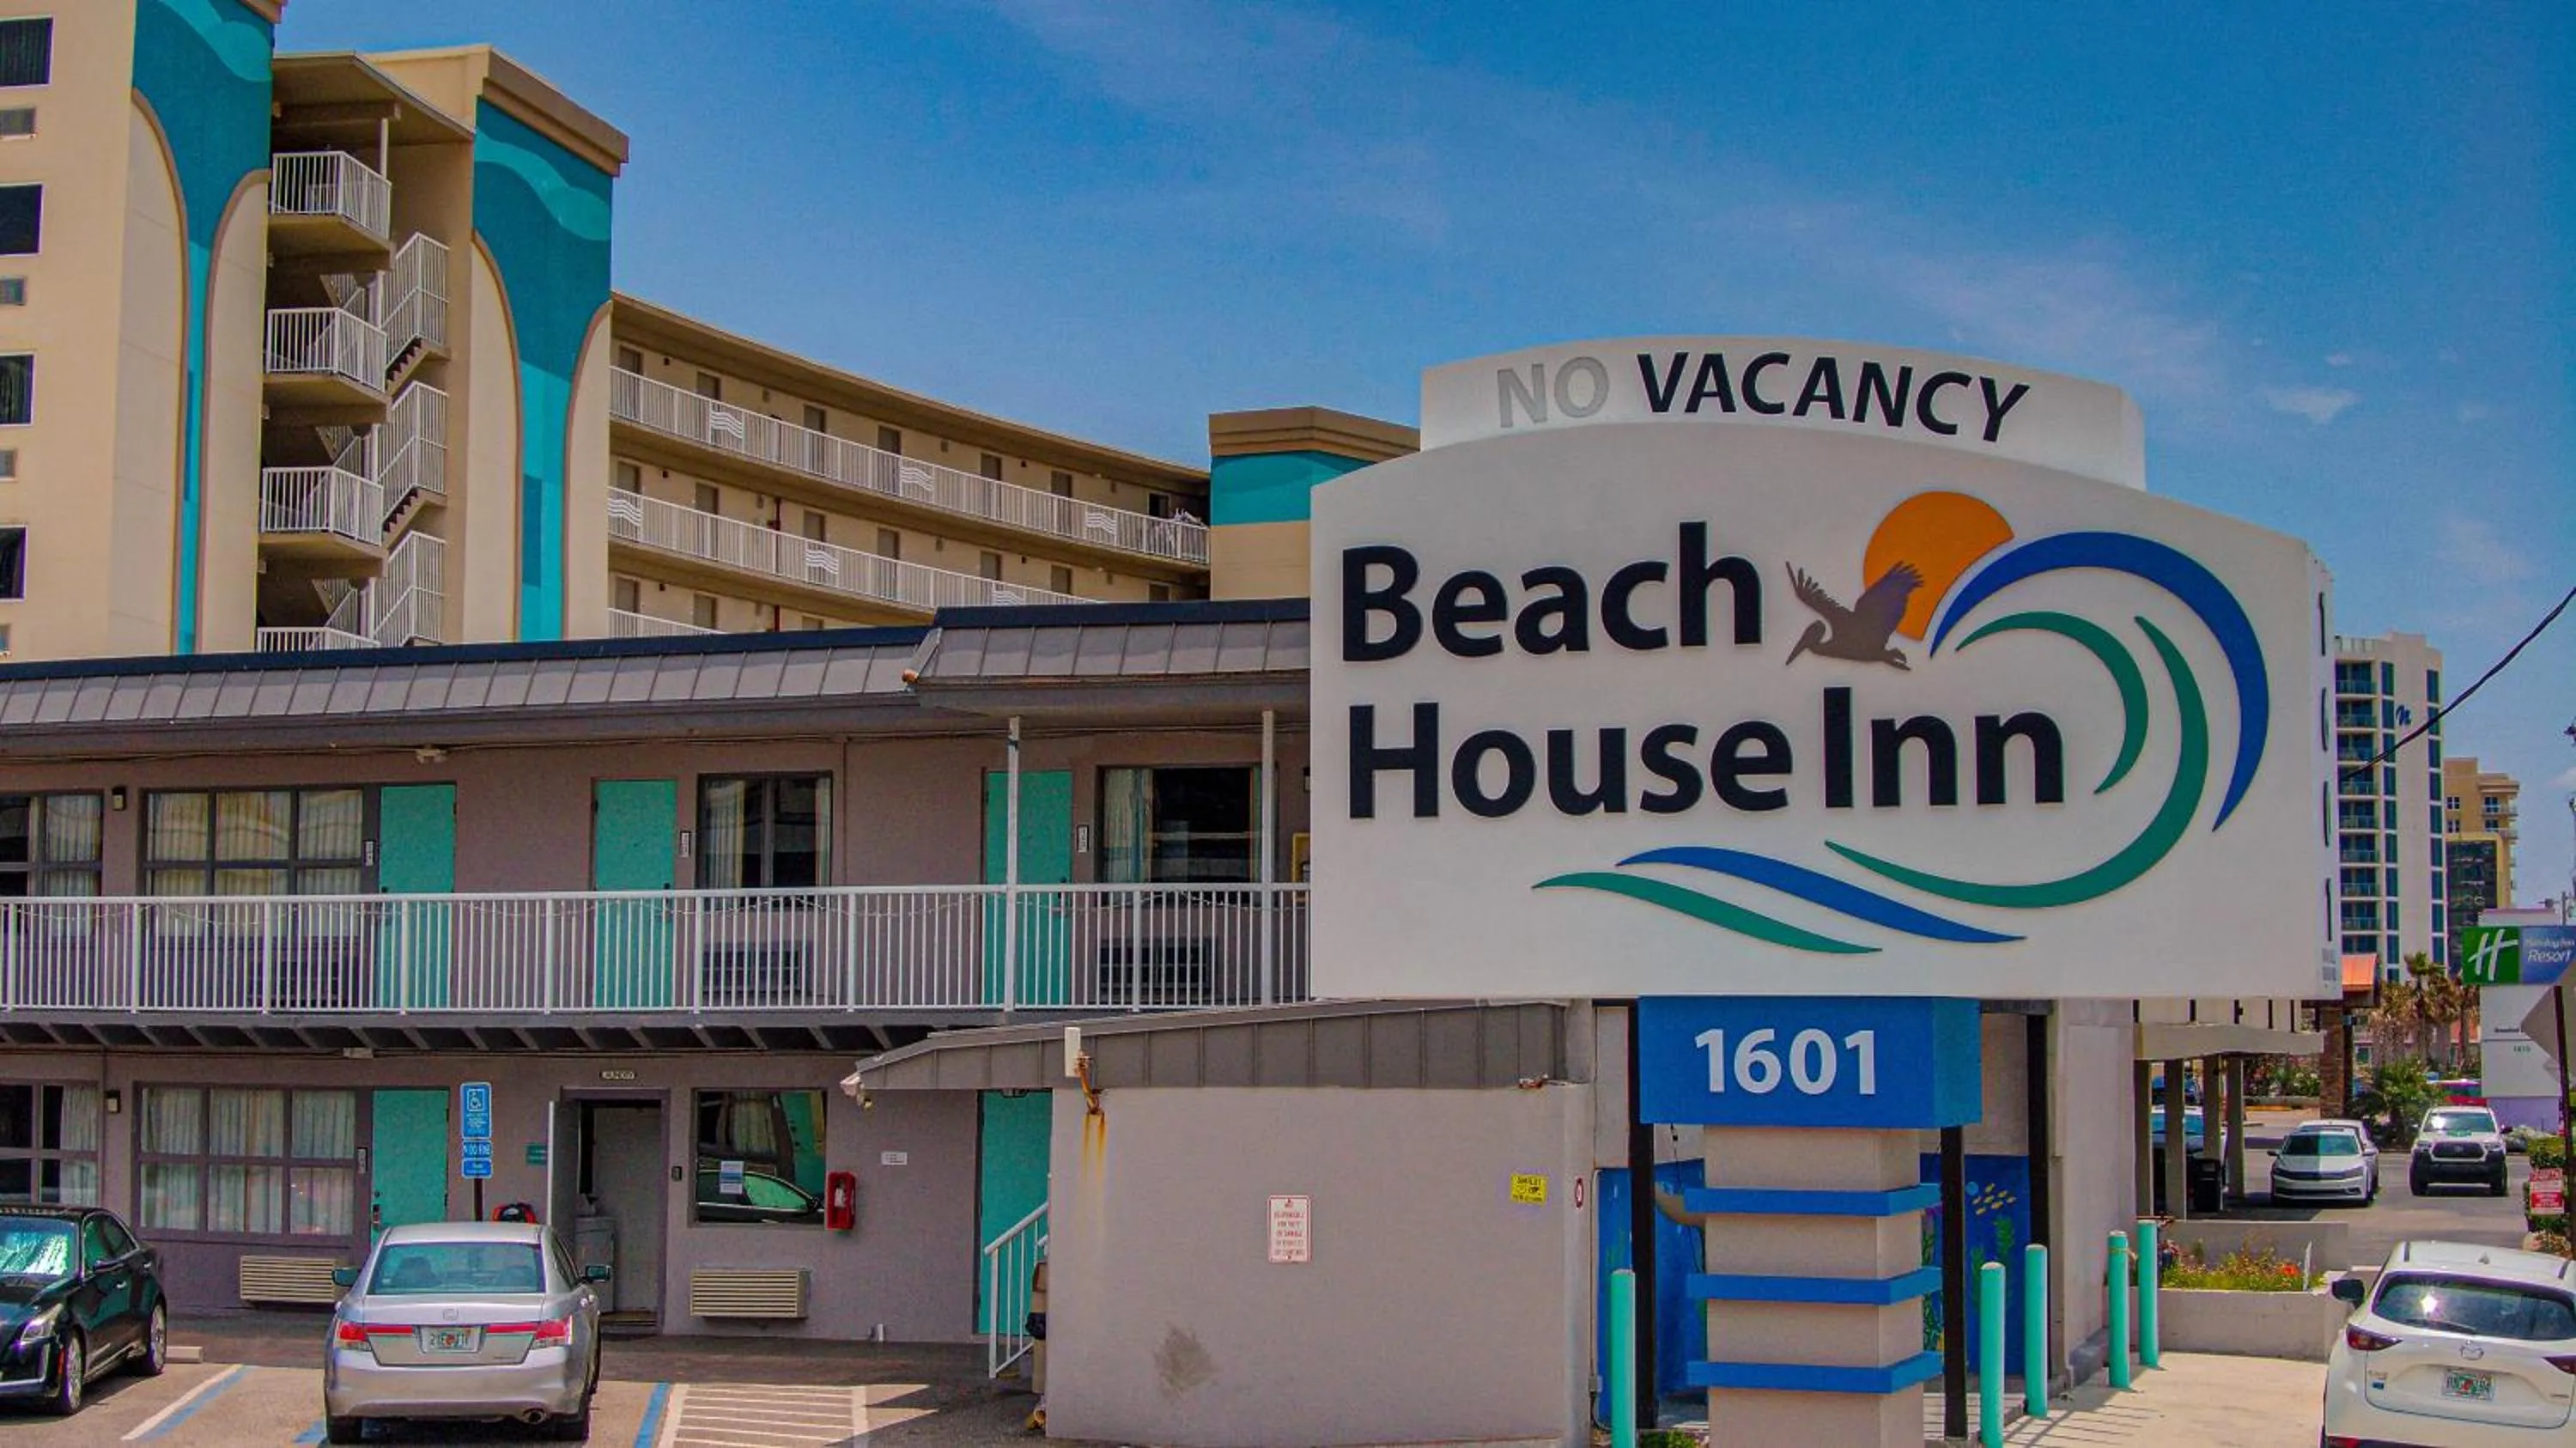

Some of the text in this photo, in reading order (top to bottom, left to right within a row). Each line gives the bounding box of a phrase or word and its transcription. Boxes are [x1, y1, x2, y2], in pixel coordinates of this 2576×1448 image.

[1497, 351, 2032, 442] NO VACANCY
[1341, 520, 1763, 662] Beach
[1348, 686, 2065, 819] House Inn
[2527, 949, 2572, 963] Resort
[1694, 1028, 1875, 1095] 1601
